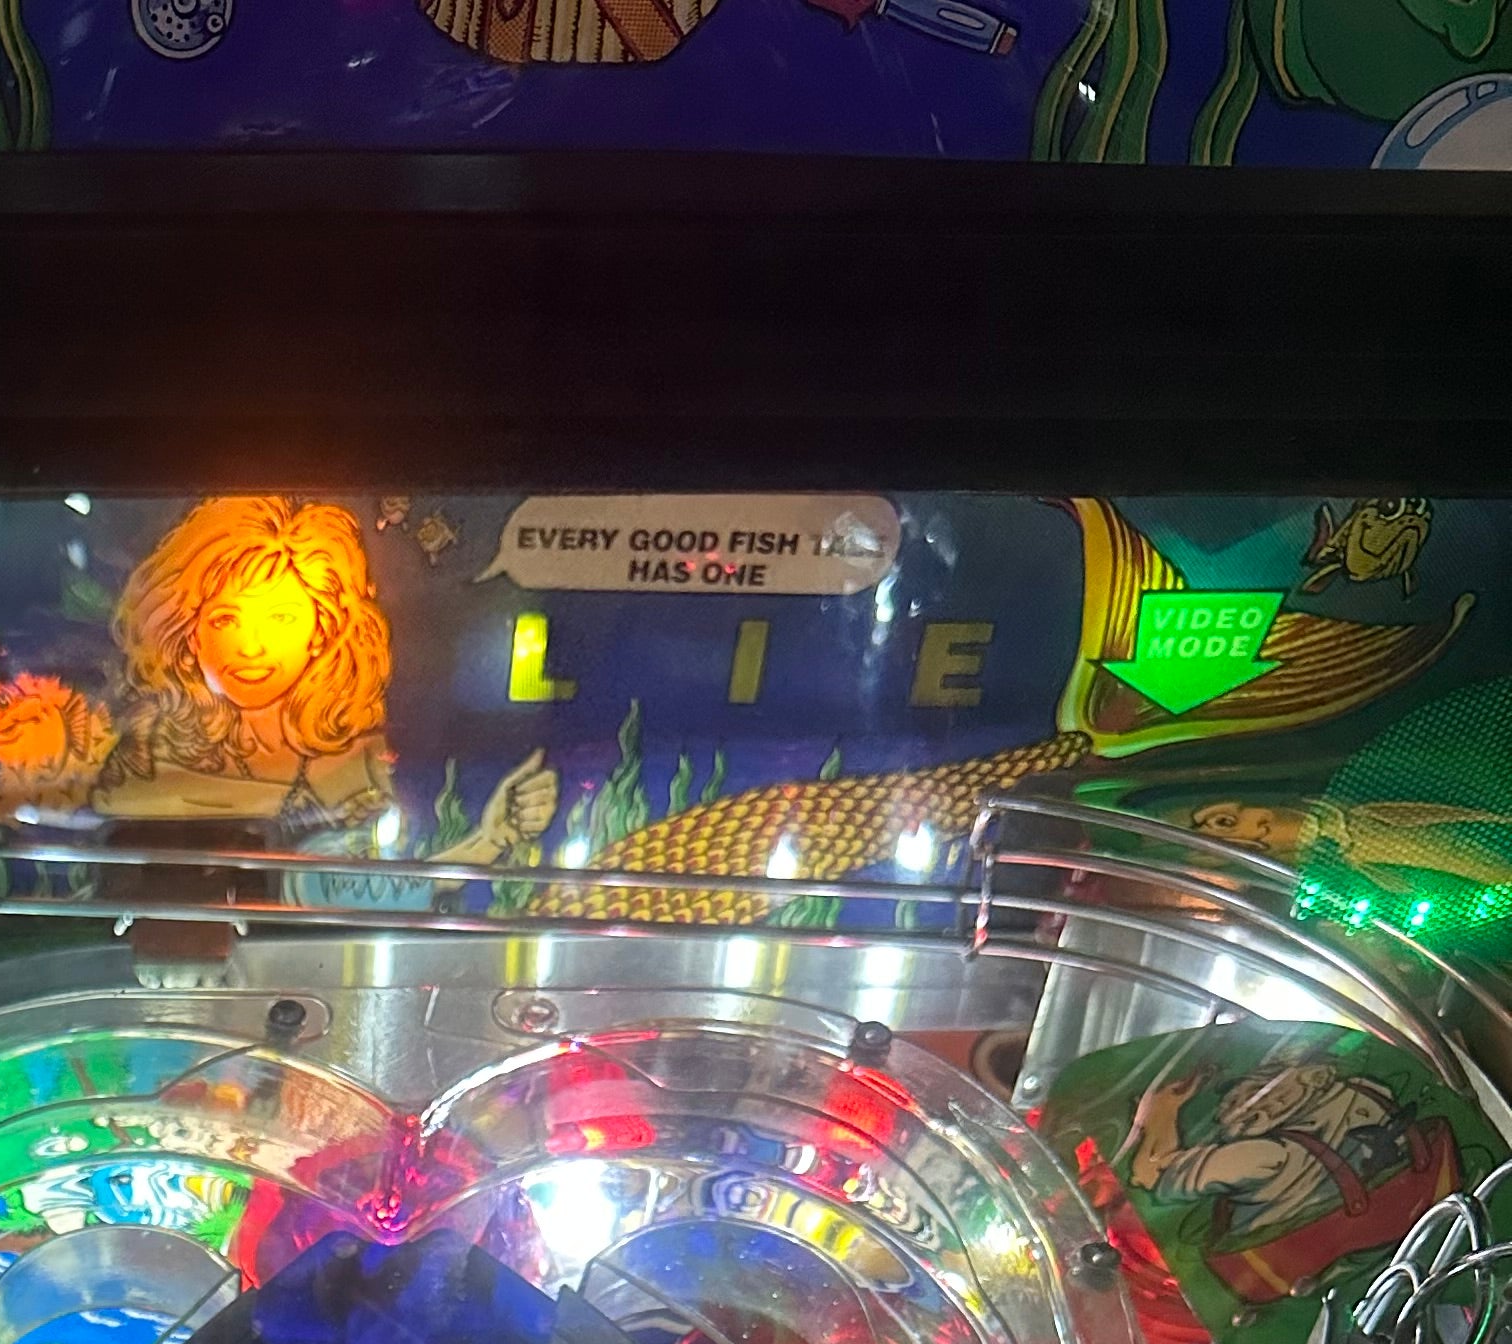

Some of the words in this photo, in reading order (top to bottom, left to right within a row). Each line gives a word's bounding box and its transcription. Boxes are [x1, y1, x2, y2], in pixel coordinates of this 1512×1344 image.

[517, 526, 618, 552] EVERY
[628, 529, 718, 554] GOOD
[728, 530, 799, 556] FISH
[627, 561, 691, 584] HAS
[701, 562, 766, 587] ONE
[1153, 605, 1263, 630] VIDEO
[1148, 635, 1251, 660] MODE
